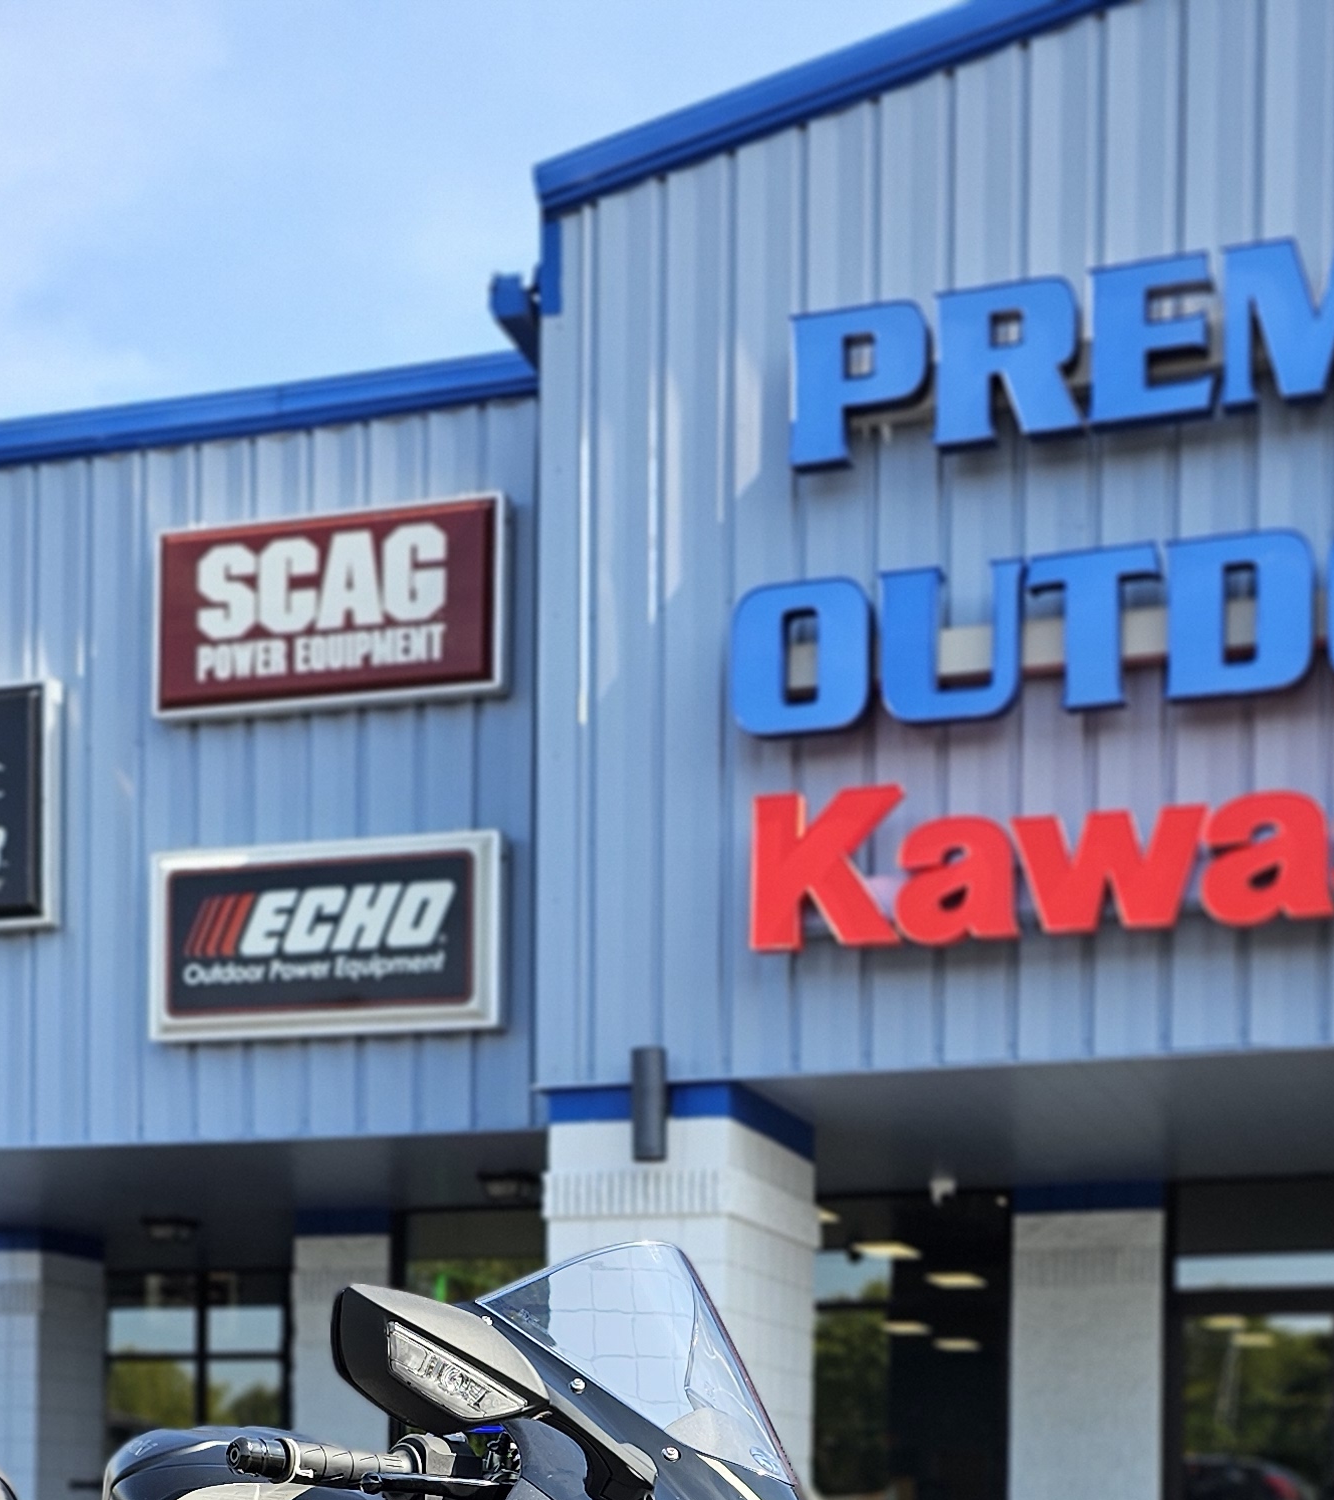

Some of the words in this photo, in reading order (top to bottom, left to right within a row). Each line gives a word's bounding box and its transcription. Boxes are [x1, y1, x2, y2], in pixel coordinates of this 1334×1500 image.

[196, 522, 448, 640] SCAG
[196, 638, 289, 683] POWER
[294, 623, 447, 674] EQUIPMENT
[239, 879, 456, 957] ECHO
[182, 962, 265, 987] Outdoor
[268, 957, 331, 981] Power
[334, 950, 446, 982] Equipment
